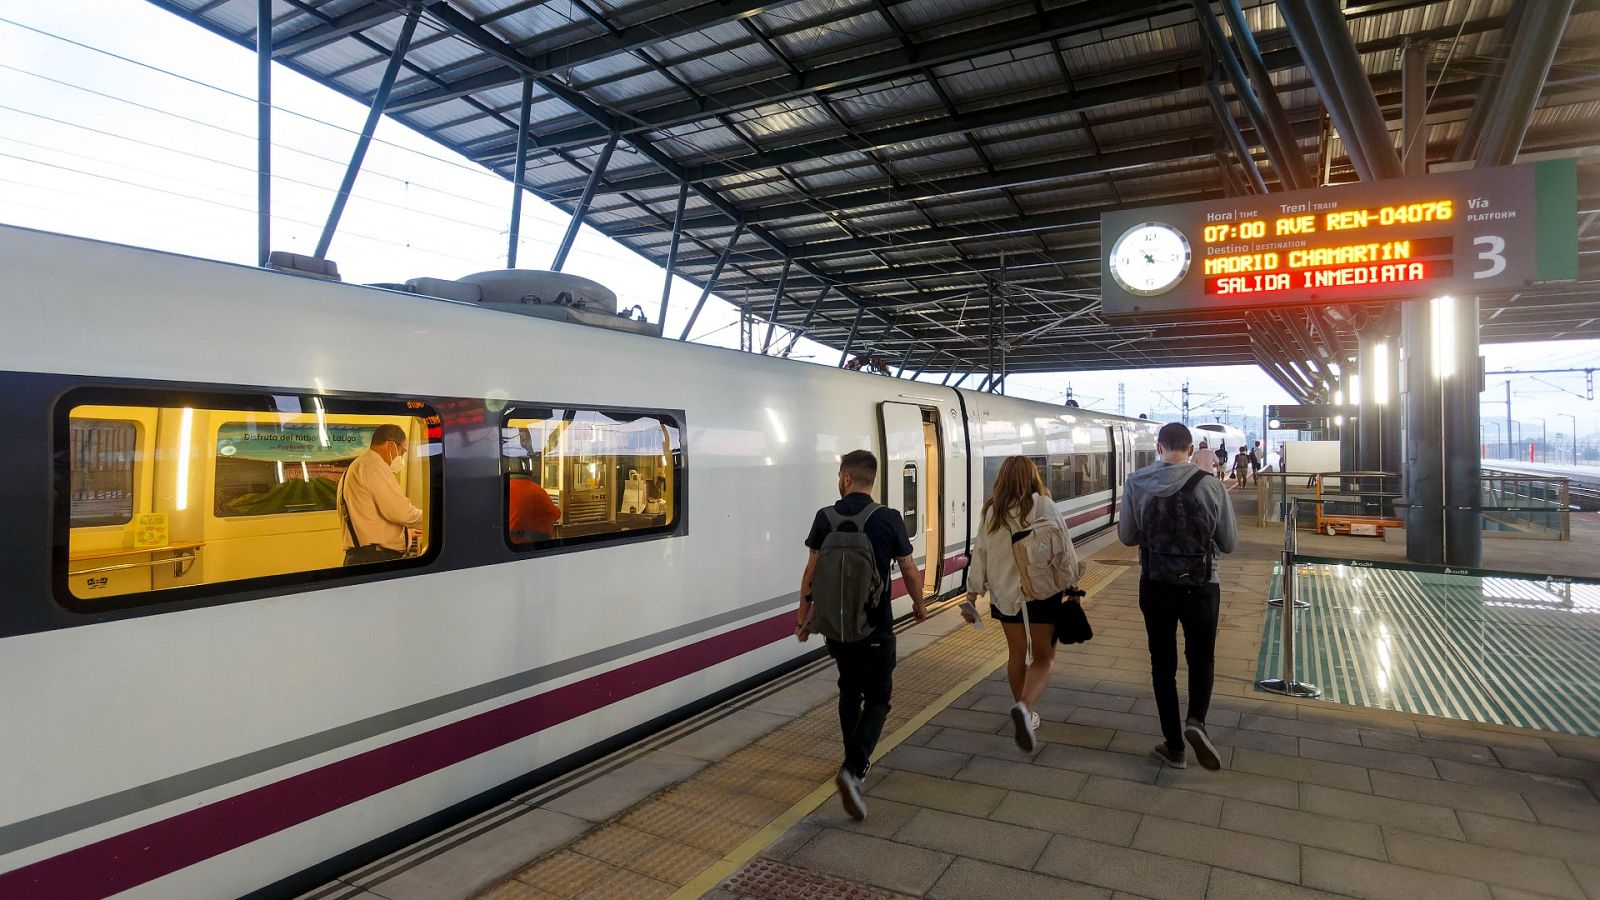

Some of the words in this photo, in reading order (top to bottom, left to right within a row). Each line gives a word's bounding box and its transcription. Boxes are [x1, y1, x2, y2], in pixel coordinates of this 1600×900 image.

[1280, 204, 1306, 214] Tren
[1312, 202, 1338, 211] TRAIN
[1467, 197, 1489, 209] Vía
[1204, 220, 1266, 243] 07:00
[1276, 215, 1316, 236] AVE
[1326, 200, 1455, 231] REN-04076
[1207, 212, 1233, 222] Hora
[1239, 210, 1259, 218] TIME
[1467, 210, 1516, 222] PLATFORM
[1207, 244, 1249, 256] Destino
[1255, 240, 1307, 251] DESTINATION
[1204, 252, 1279, 275] MADRID
[1473, 235, 1507, 280] 3
[1216, 273, 1291, 295] SALIDA
[1303, 262, 1424, 289] INMEDIATA
[244, 433, 278, 441] Disfruta
